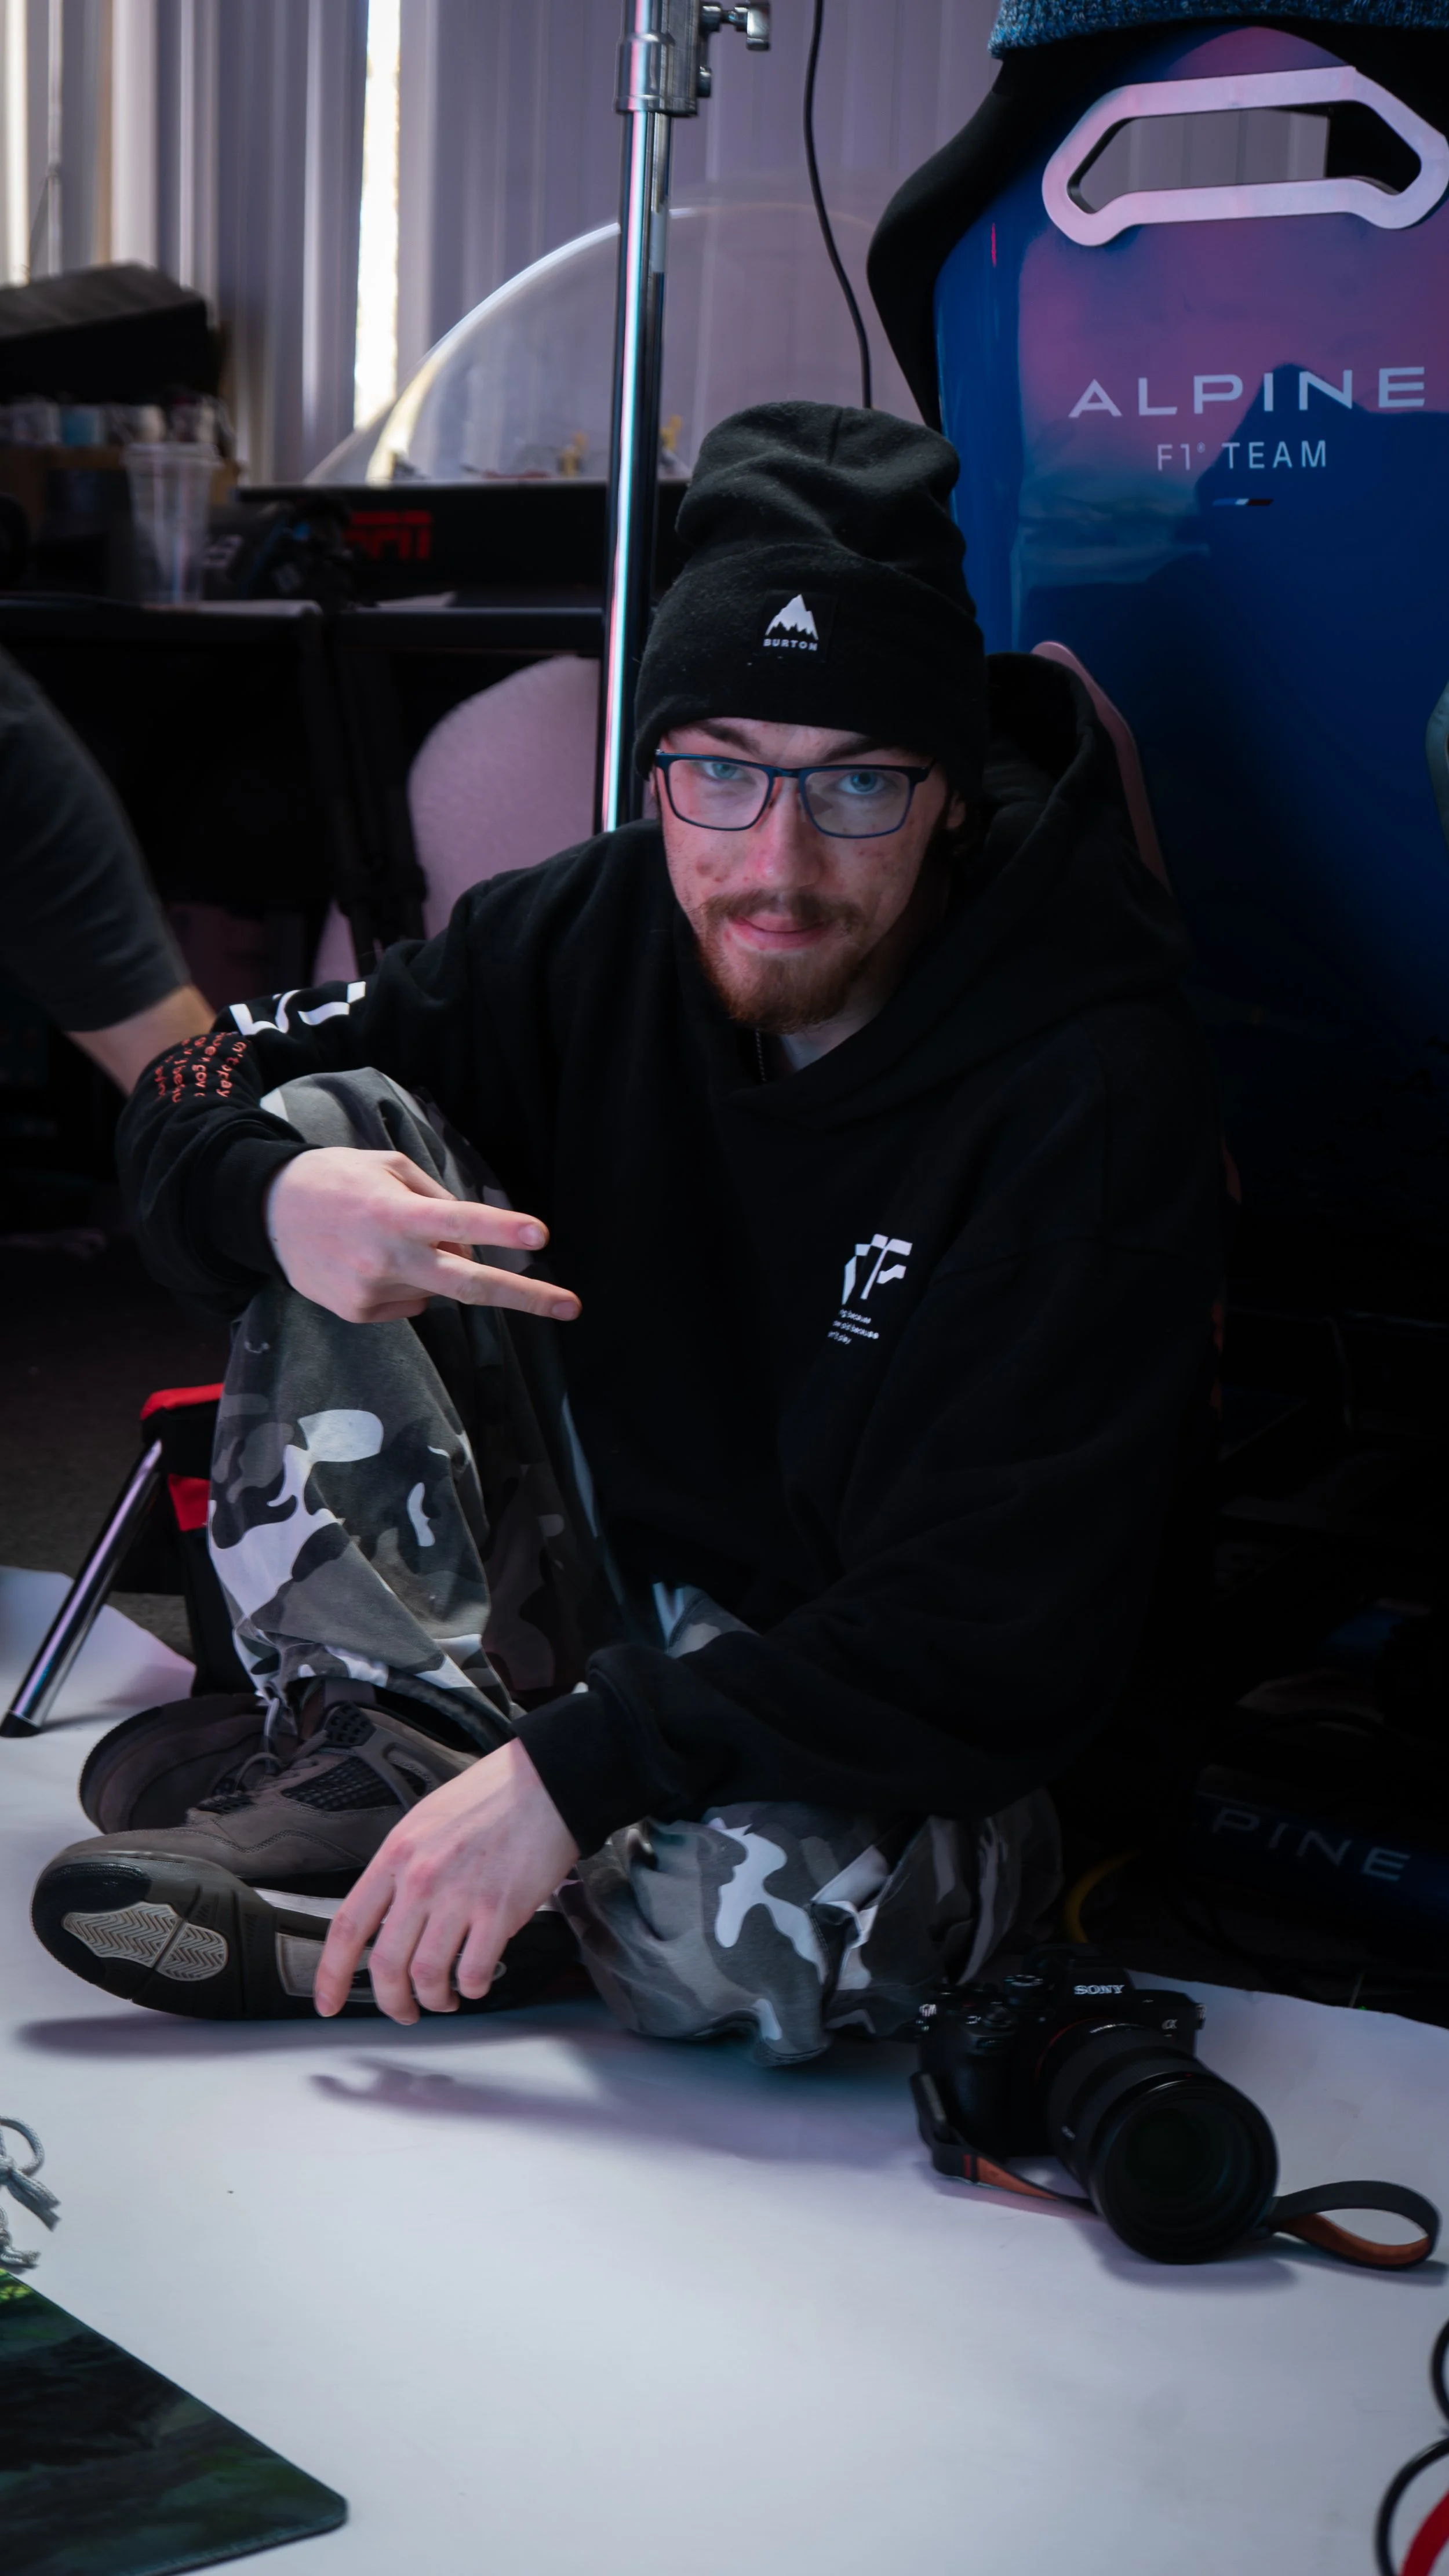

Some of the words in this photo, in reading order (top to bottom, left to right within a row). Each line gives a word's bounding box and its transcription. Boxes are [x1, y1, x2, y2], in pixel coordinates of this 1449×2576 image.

[1069, 367, 1425, 417] ALPINE
[1222, 440, 1327, 469] TEAM
[763, 639, 818, 651] BURTON
[1072, 1984, 1126, 1995] SONY
